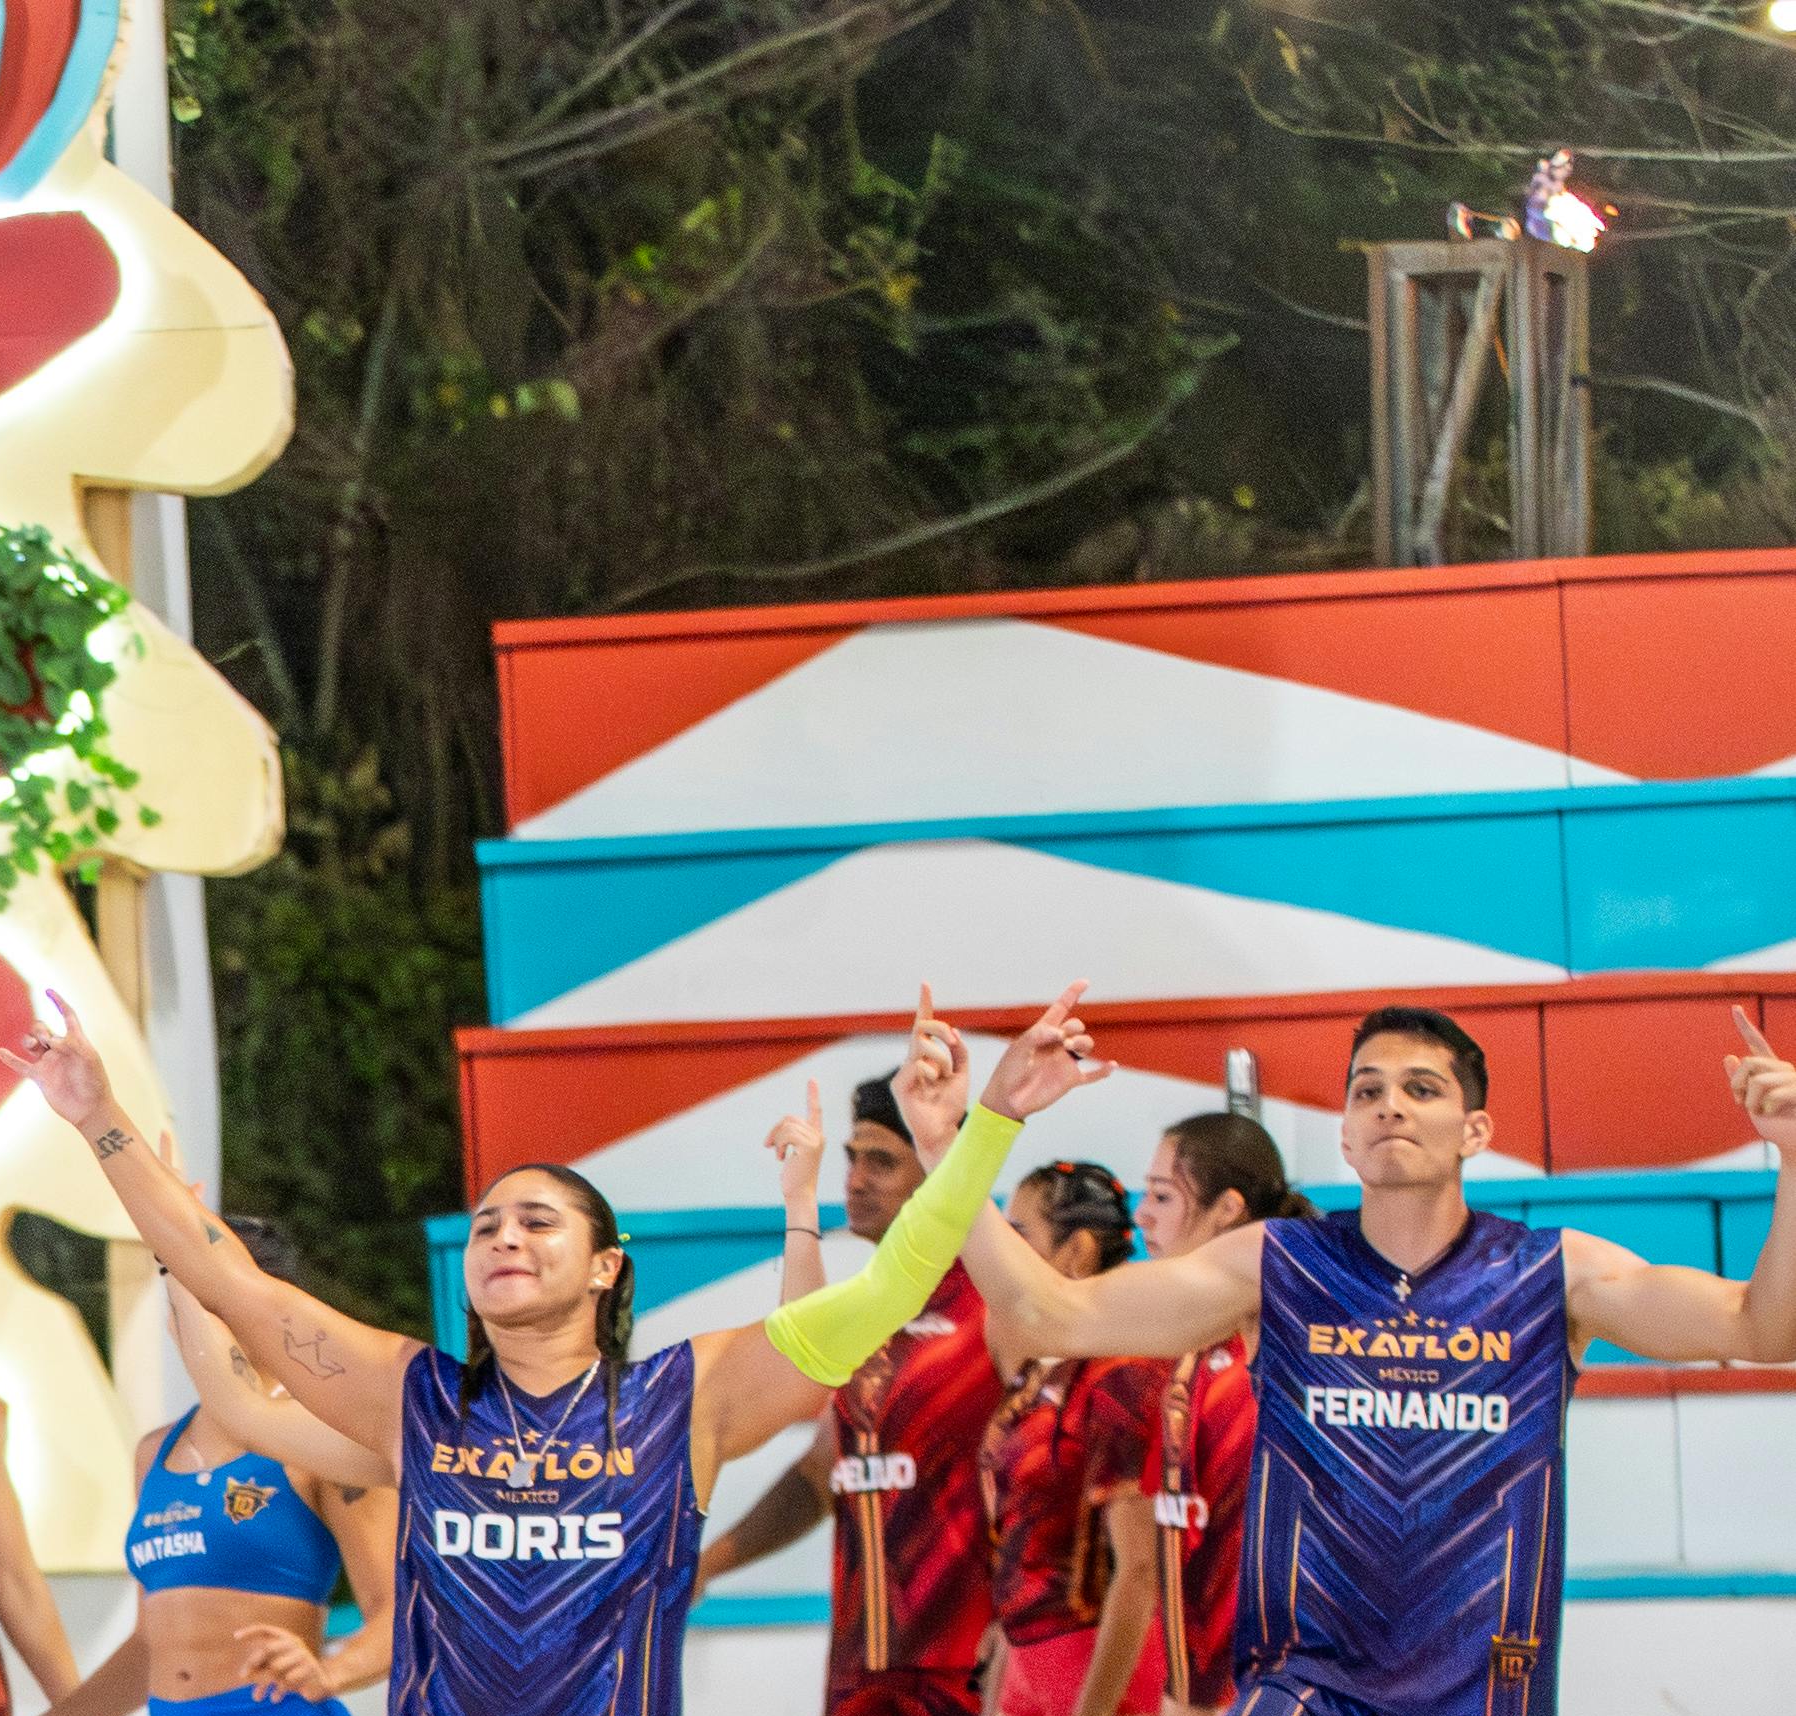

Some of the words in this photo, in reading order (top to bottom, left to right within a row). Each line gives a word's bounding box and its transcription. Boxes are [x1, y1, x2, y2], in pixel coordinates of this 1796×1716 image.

[1306, 1385, 1510, 1434] FERNANDO
[131, 1530, 207, 1569] NATASHA
[434, 1510, 625, 1562] DORIS
